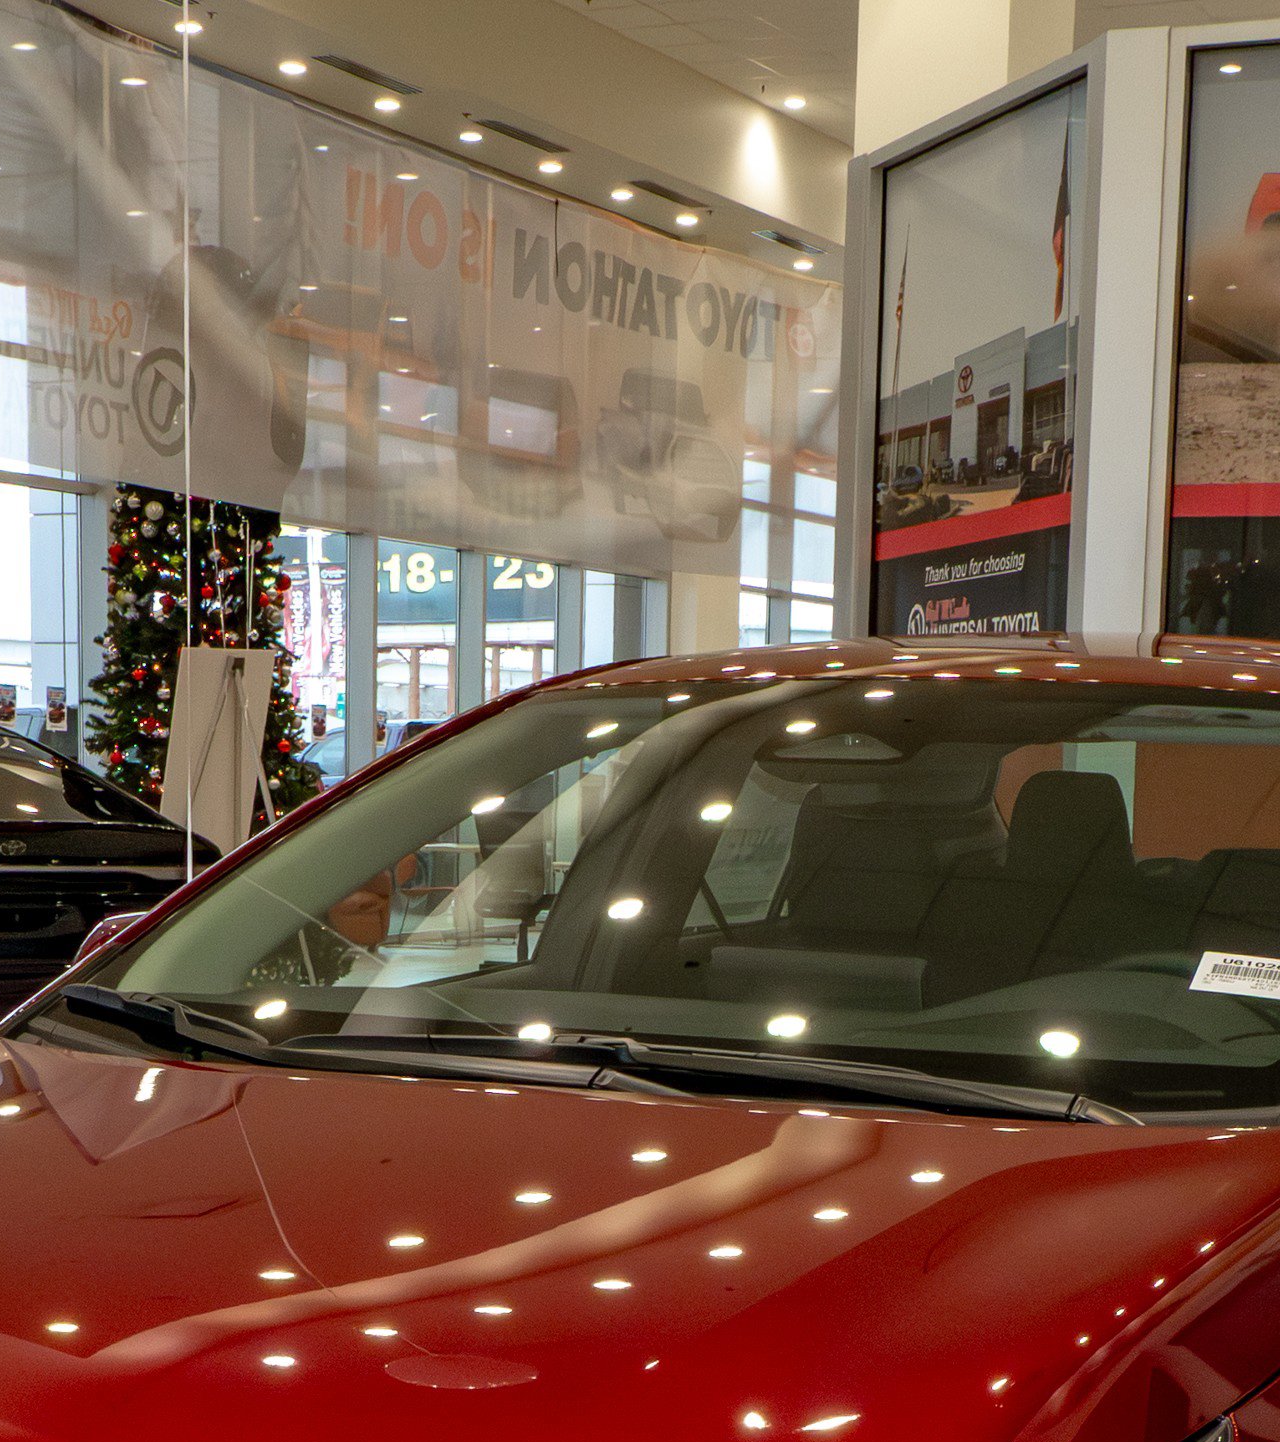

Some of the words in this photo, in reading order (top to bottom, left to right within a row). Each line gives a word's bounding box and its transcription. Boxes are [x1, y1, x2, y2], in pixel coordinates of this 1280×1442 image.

[924, 563, 949, 583] Thank
[950, 563, 968, 581] you
[969, 558, 983, 576] for
[983, 551, 1026, 573] choosing
[992, 611, 1040, 633] TOYOTA
